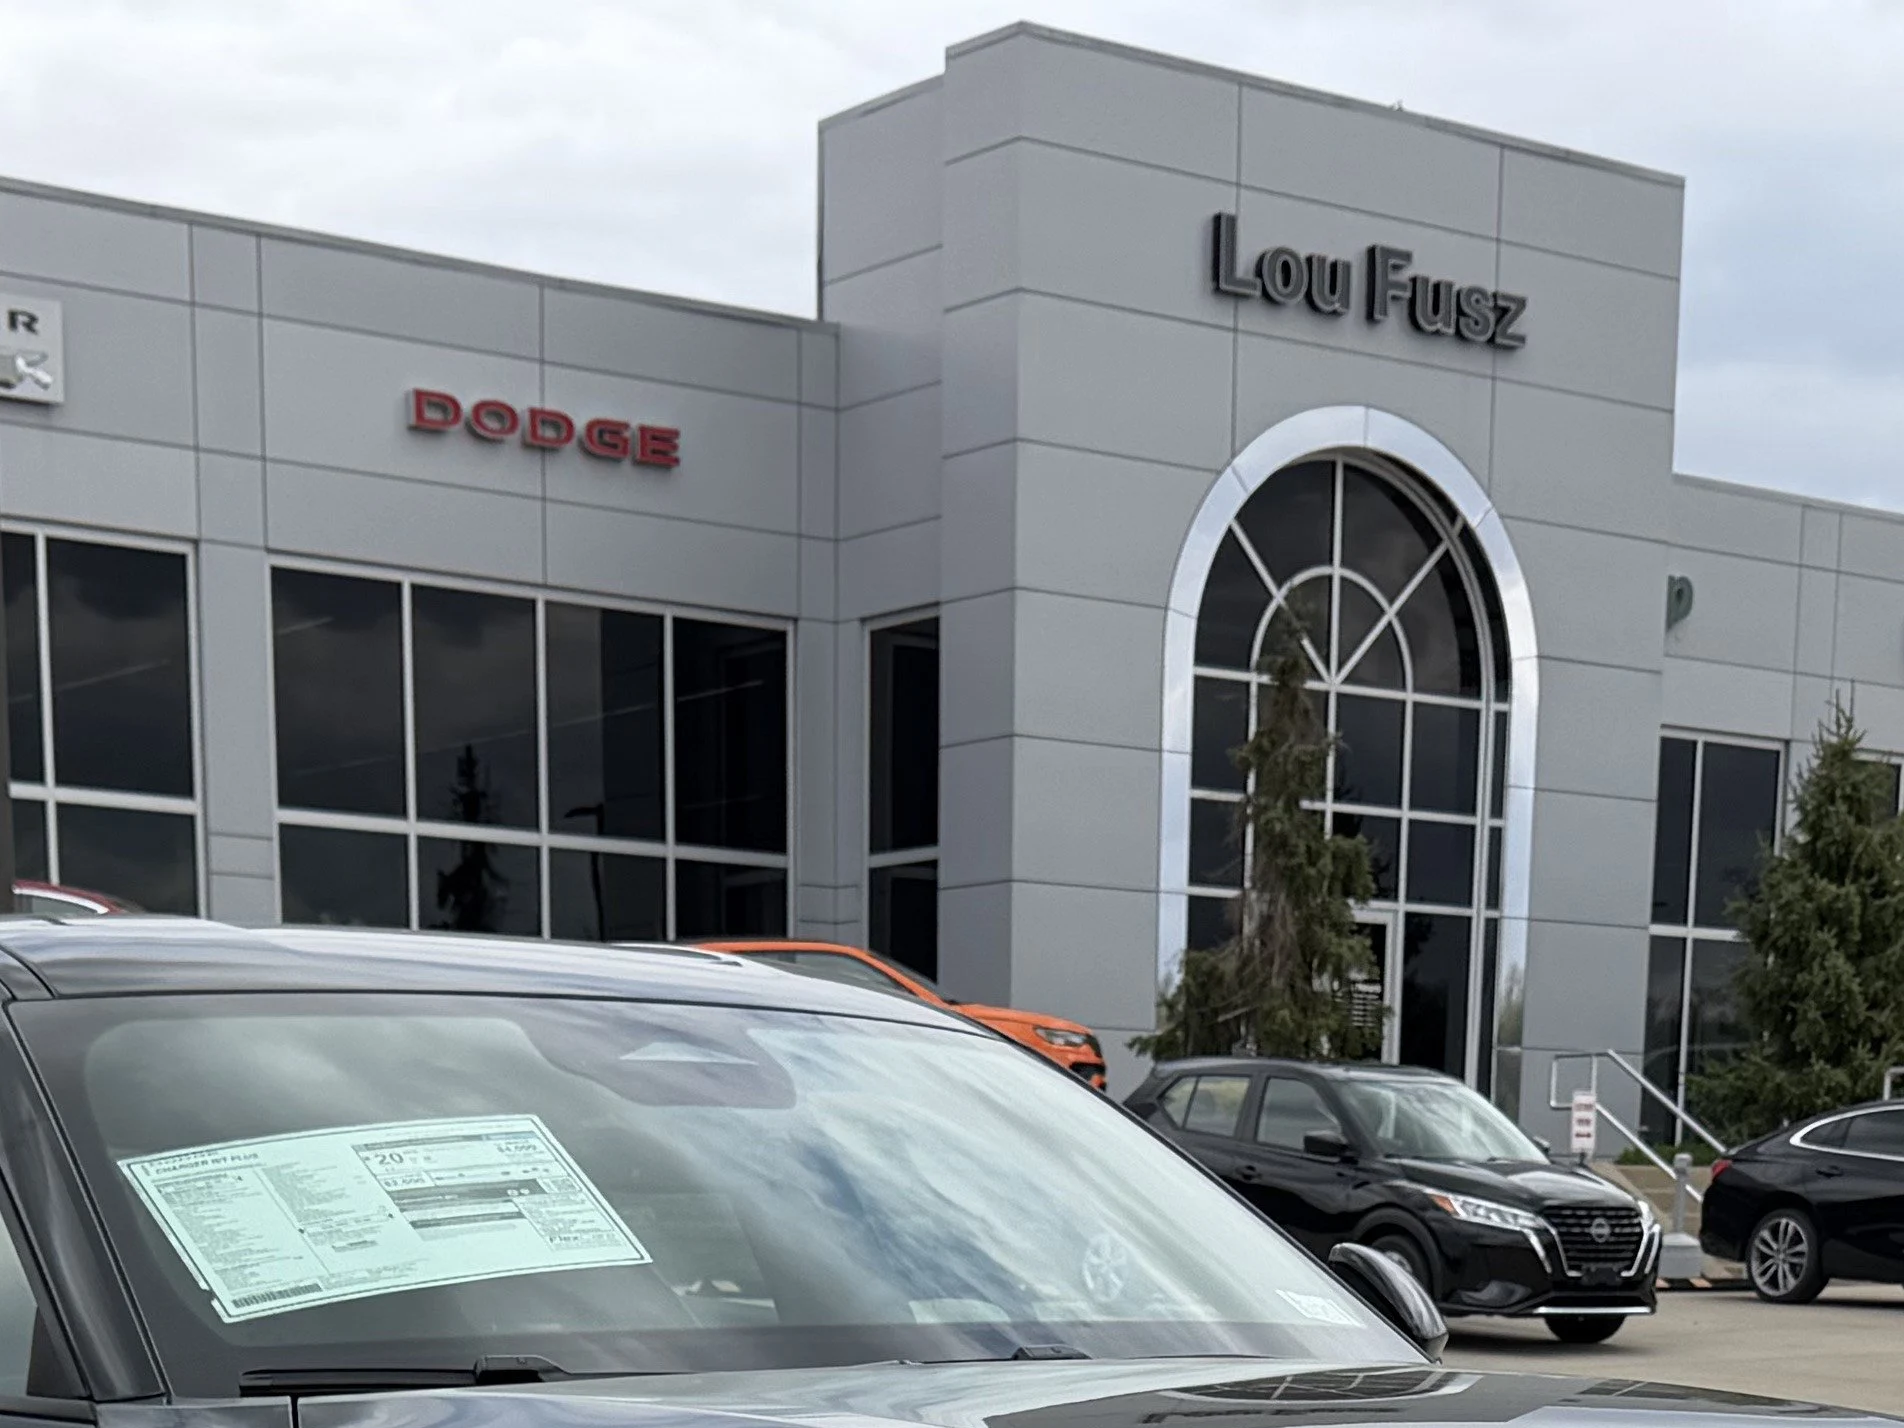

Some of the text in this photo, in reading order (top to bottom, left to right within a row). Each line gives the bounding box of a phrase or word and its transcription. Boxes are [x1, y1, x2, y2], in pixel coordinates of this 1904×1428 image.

[1212, 211, 1528, 349] Lou Fusz
[408, 387, 681, 469] DODGE
[373, 1151, 405, 1166] 20
